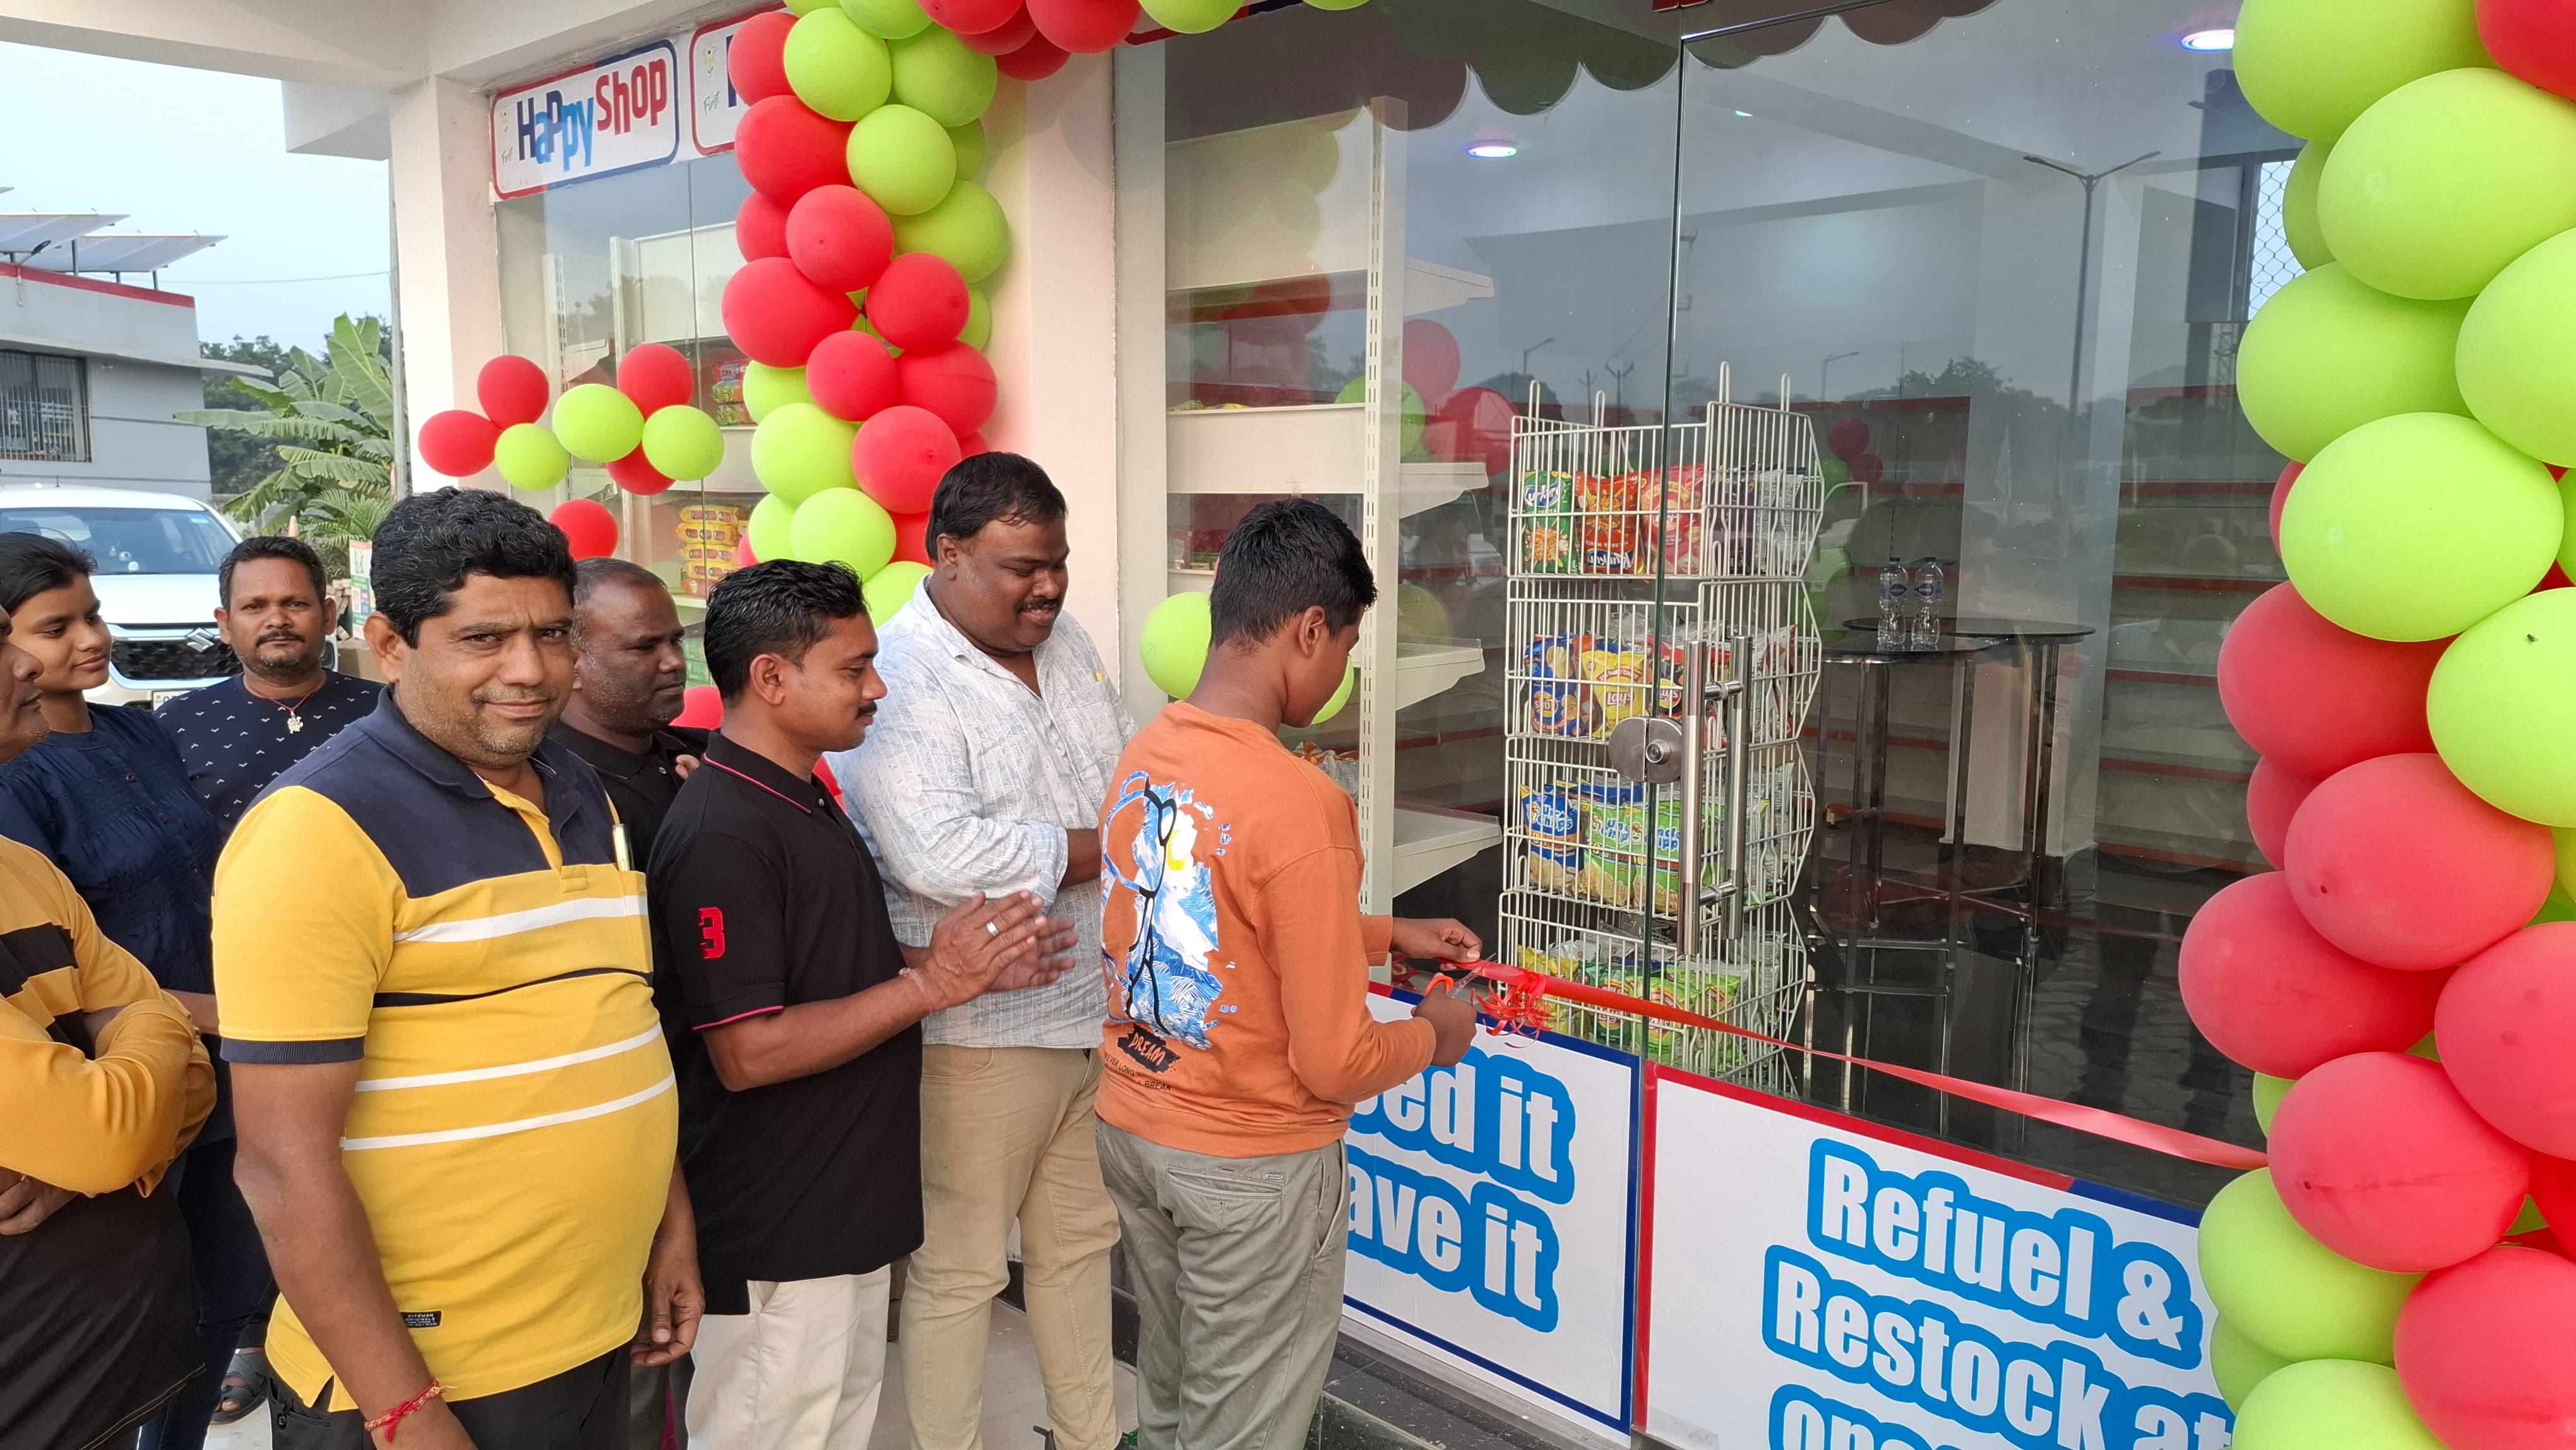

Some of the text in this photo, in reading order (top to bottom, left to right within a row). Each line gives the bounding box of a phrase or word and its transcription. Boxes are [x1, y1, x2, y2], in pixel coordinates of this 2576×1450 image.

[596, 58, 667, 135] Shop
[698, 907, 725, 959] 3
[1118, 1063, 1135, 1077] LONG
[1129, 1032, 1166, 1066] DREAM
[1144, 1081, 1172, 1091] BREAK
[1355, 1062, 1558, 1183] ed it
[1484, 1202, 1542, 1312] it
[1822, 1154, 2184, 1351] Refuel &
[1776, 1261, 2109, 1450] Restock
